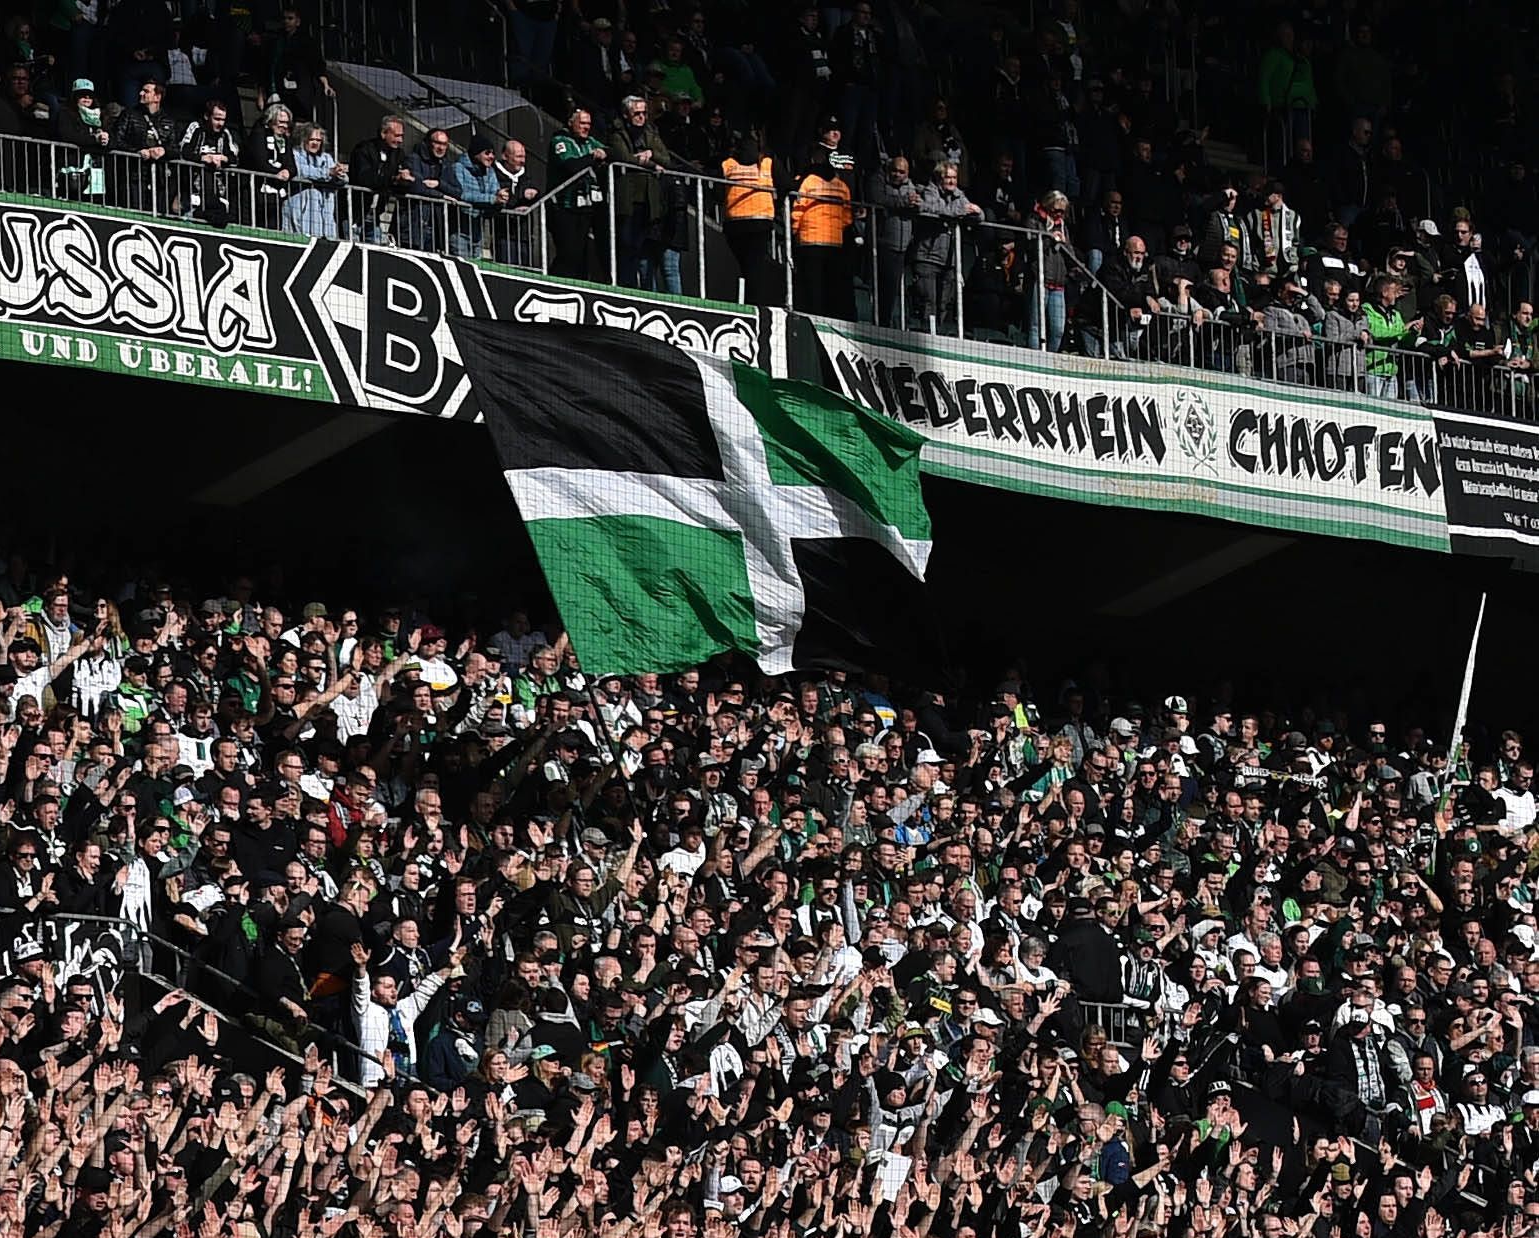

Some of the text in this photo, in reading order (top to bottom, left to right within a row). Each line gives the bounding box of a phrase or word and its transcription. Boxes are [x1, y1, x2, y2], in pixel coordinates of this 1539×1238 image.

[18, 328, 99, 363] UND
[115, 339, 315, 393] ÜBERALL!
[835, 349, 1442, 498] NIEDERRHEIN CHAOTEN
